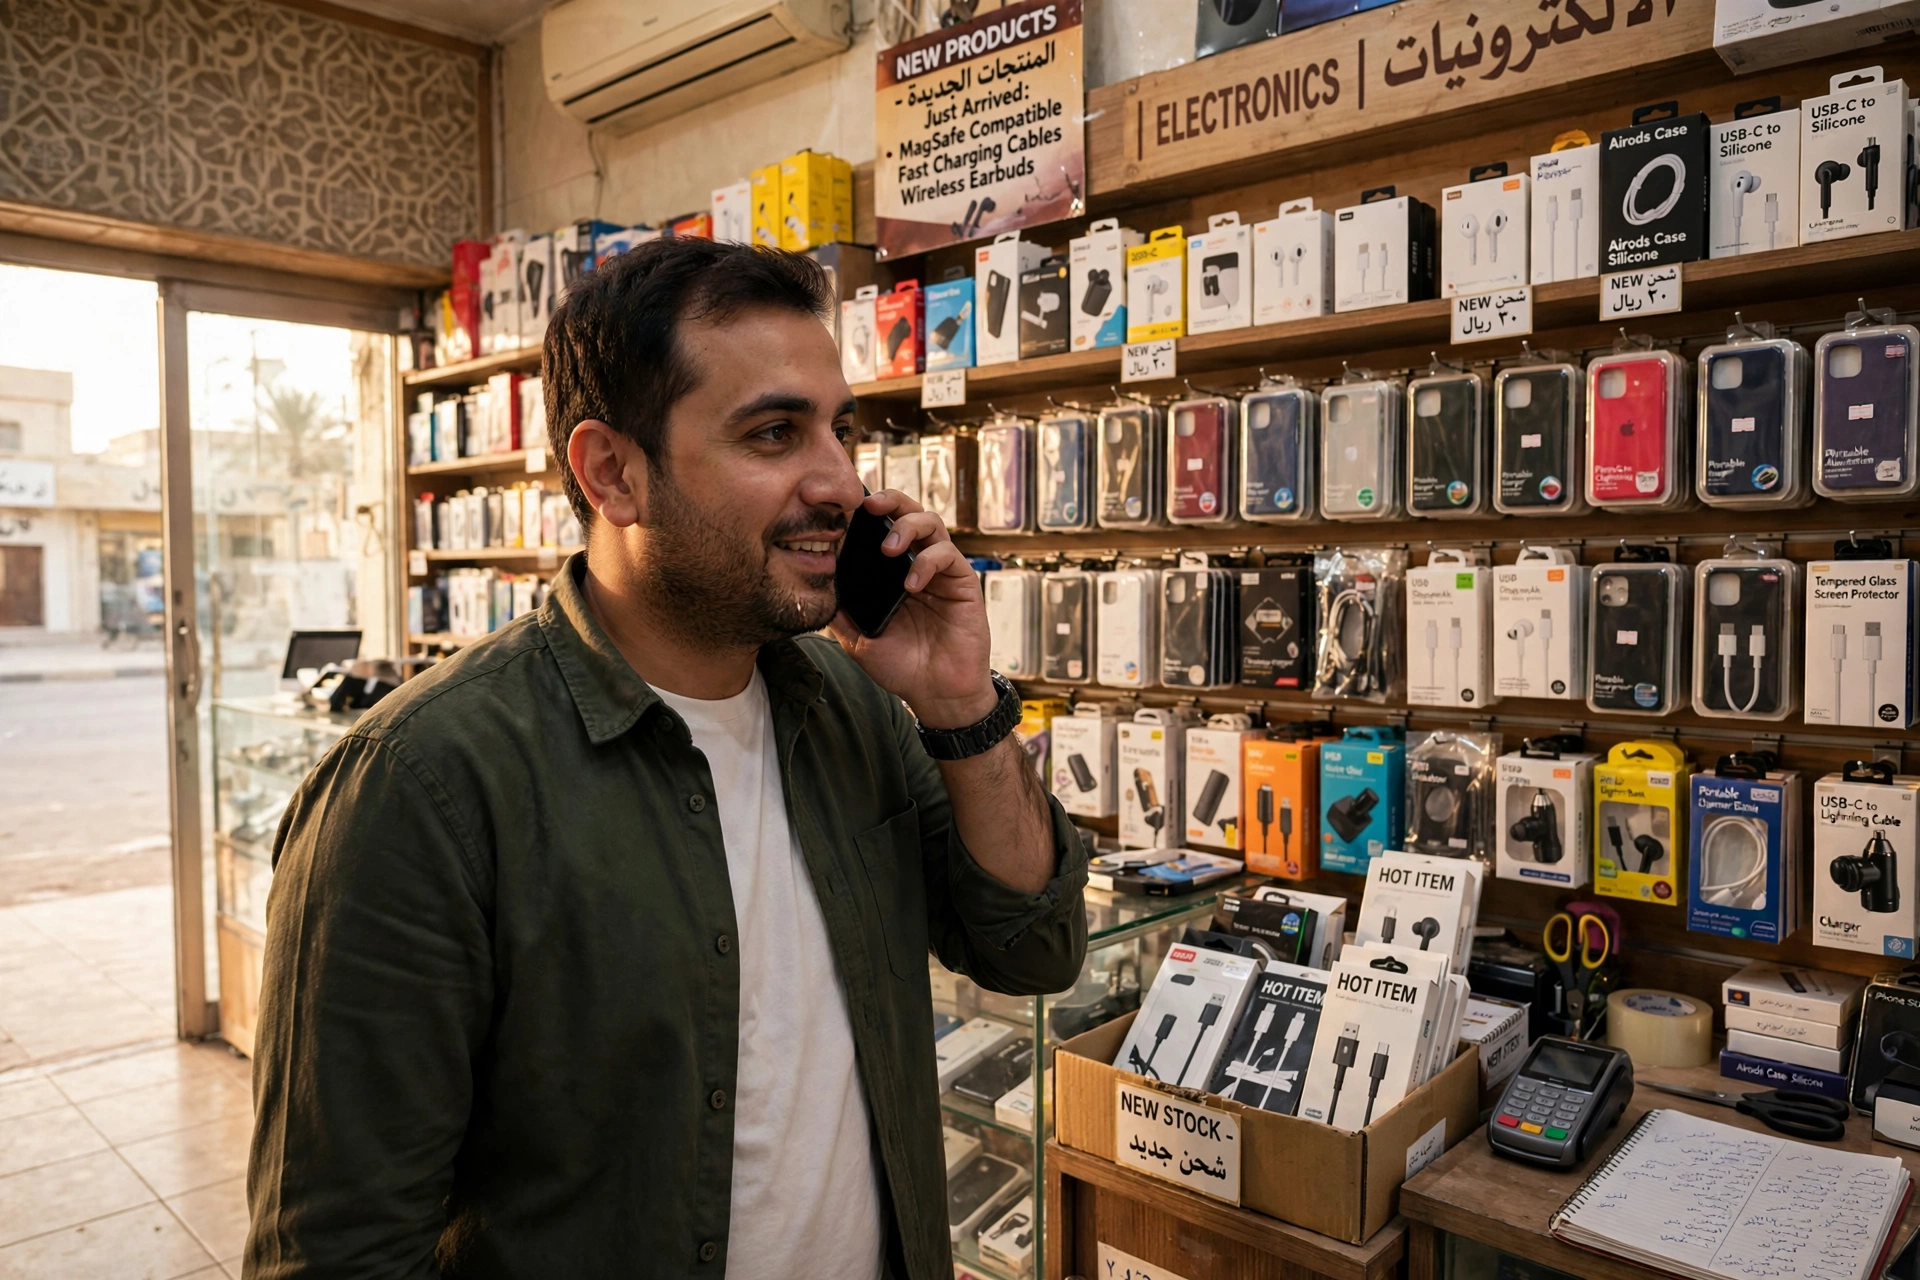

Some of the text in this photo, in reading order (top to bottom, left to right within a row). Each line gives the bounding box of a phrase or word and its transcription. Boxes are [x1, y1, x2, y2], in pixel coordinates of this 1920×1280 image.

[896, 5, 1057, 79] NEW PRODUCTS
[977, 40, 1056, 84] المنتجات
[907, 67, 971, 107] الجديدة
[924, 84, 1030, 129] Just Arrived:
[1157, 58, 1340, 146] ELECTRONICS
[1811, 98, 1876, 118] USB-C to
[900, 100, 1062, 160] MagSafe Compatible
[1720, 124, 1781, 143] USB-C to
[1811, 114, 1866, 132] Silicone
[1609, 124, 1688, 150] Airods Case
[899, 125, 1062, 183] Fast Charging Cables
[1720, 140, 1772, 157] Silicone
[900, 158, 1035, 206] Wireless Earbuds
[1608, 231, 1687, 252] Airods Case
[1608, 250, 1659, 266] Silicone
[1611, 268, 1677, 289] NEW شحن
[1459, 290, 1526, 312] NEW شحن
[1613, 294, 1642, 312] ريال
[1463, 316, 1492, 335] ريال
[1128, 345, 1149, 357] NEW
[1815, 575, 1897, 589] Tempered Glass
[1814, 589, 1900, 599] Screen Protector
[1821, 796, 1878, 811] USB-C to
[1378, 867, 1455, 891] HOT ITEM
[1261, 980, 1327, 1005] HOT ITEM
[1337, 972, 1418, 1004] HOT ITEM
[1766, 1068, 1788, 1080] Case
[1121, 1091, 1159, 1121] NEW
[1163, 1105, 1221, 1142] STOCK
[1129, 1134, 1227, 1180] شحن جديد
